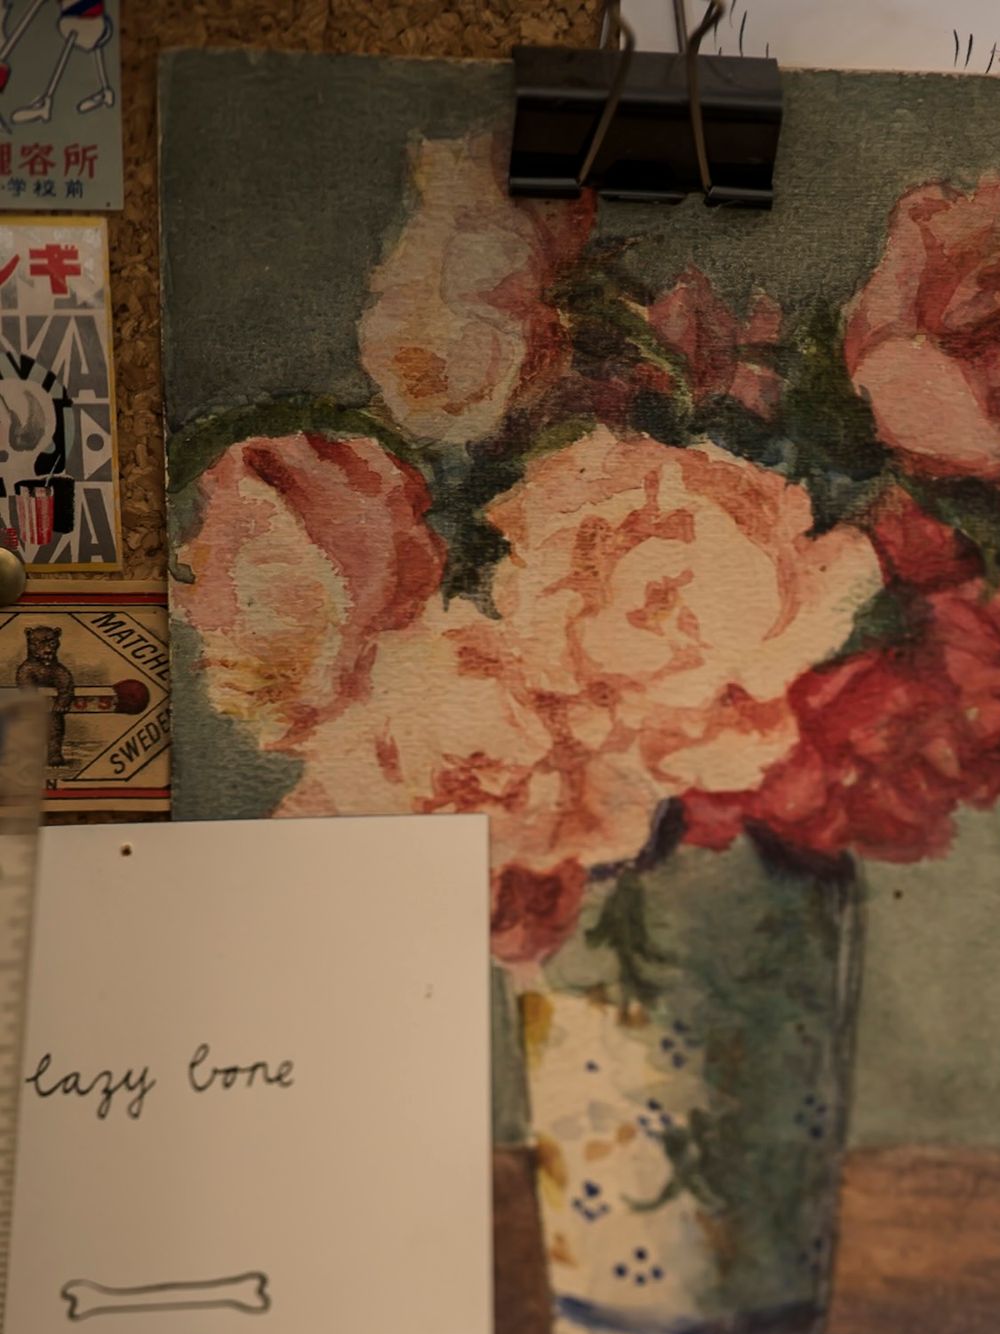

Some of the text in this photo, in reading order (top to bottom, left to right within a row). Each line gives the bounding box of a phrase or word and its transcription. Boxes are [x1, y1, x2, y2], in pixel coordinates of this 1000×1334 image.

[1, 177, 84, 198] 学校前
[25, 1043, 294, 1120] lazy bone
